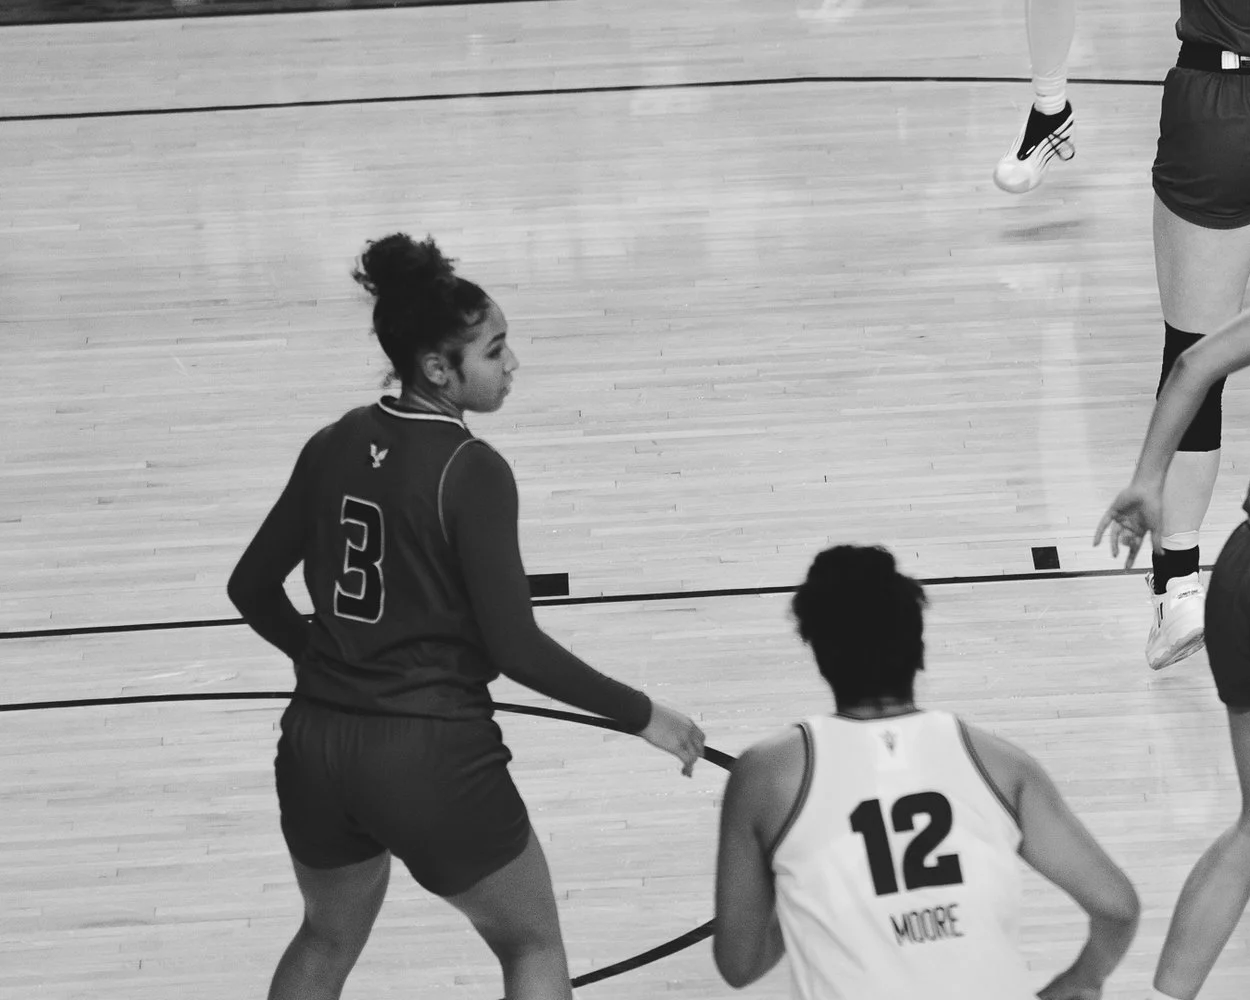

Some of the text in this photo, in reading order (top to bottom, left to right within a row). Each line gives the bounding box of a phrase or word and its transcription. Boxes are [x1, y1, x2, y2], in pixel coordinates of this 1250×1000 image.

[333, 495, 385, 624] 3
[849, 791, 964, 896] 12
[890, 903, 965, 946] MOORE
